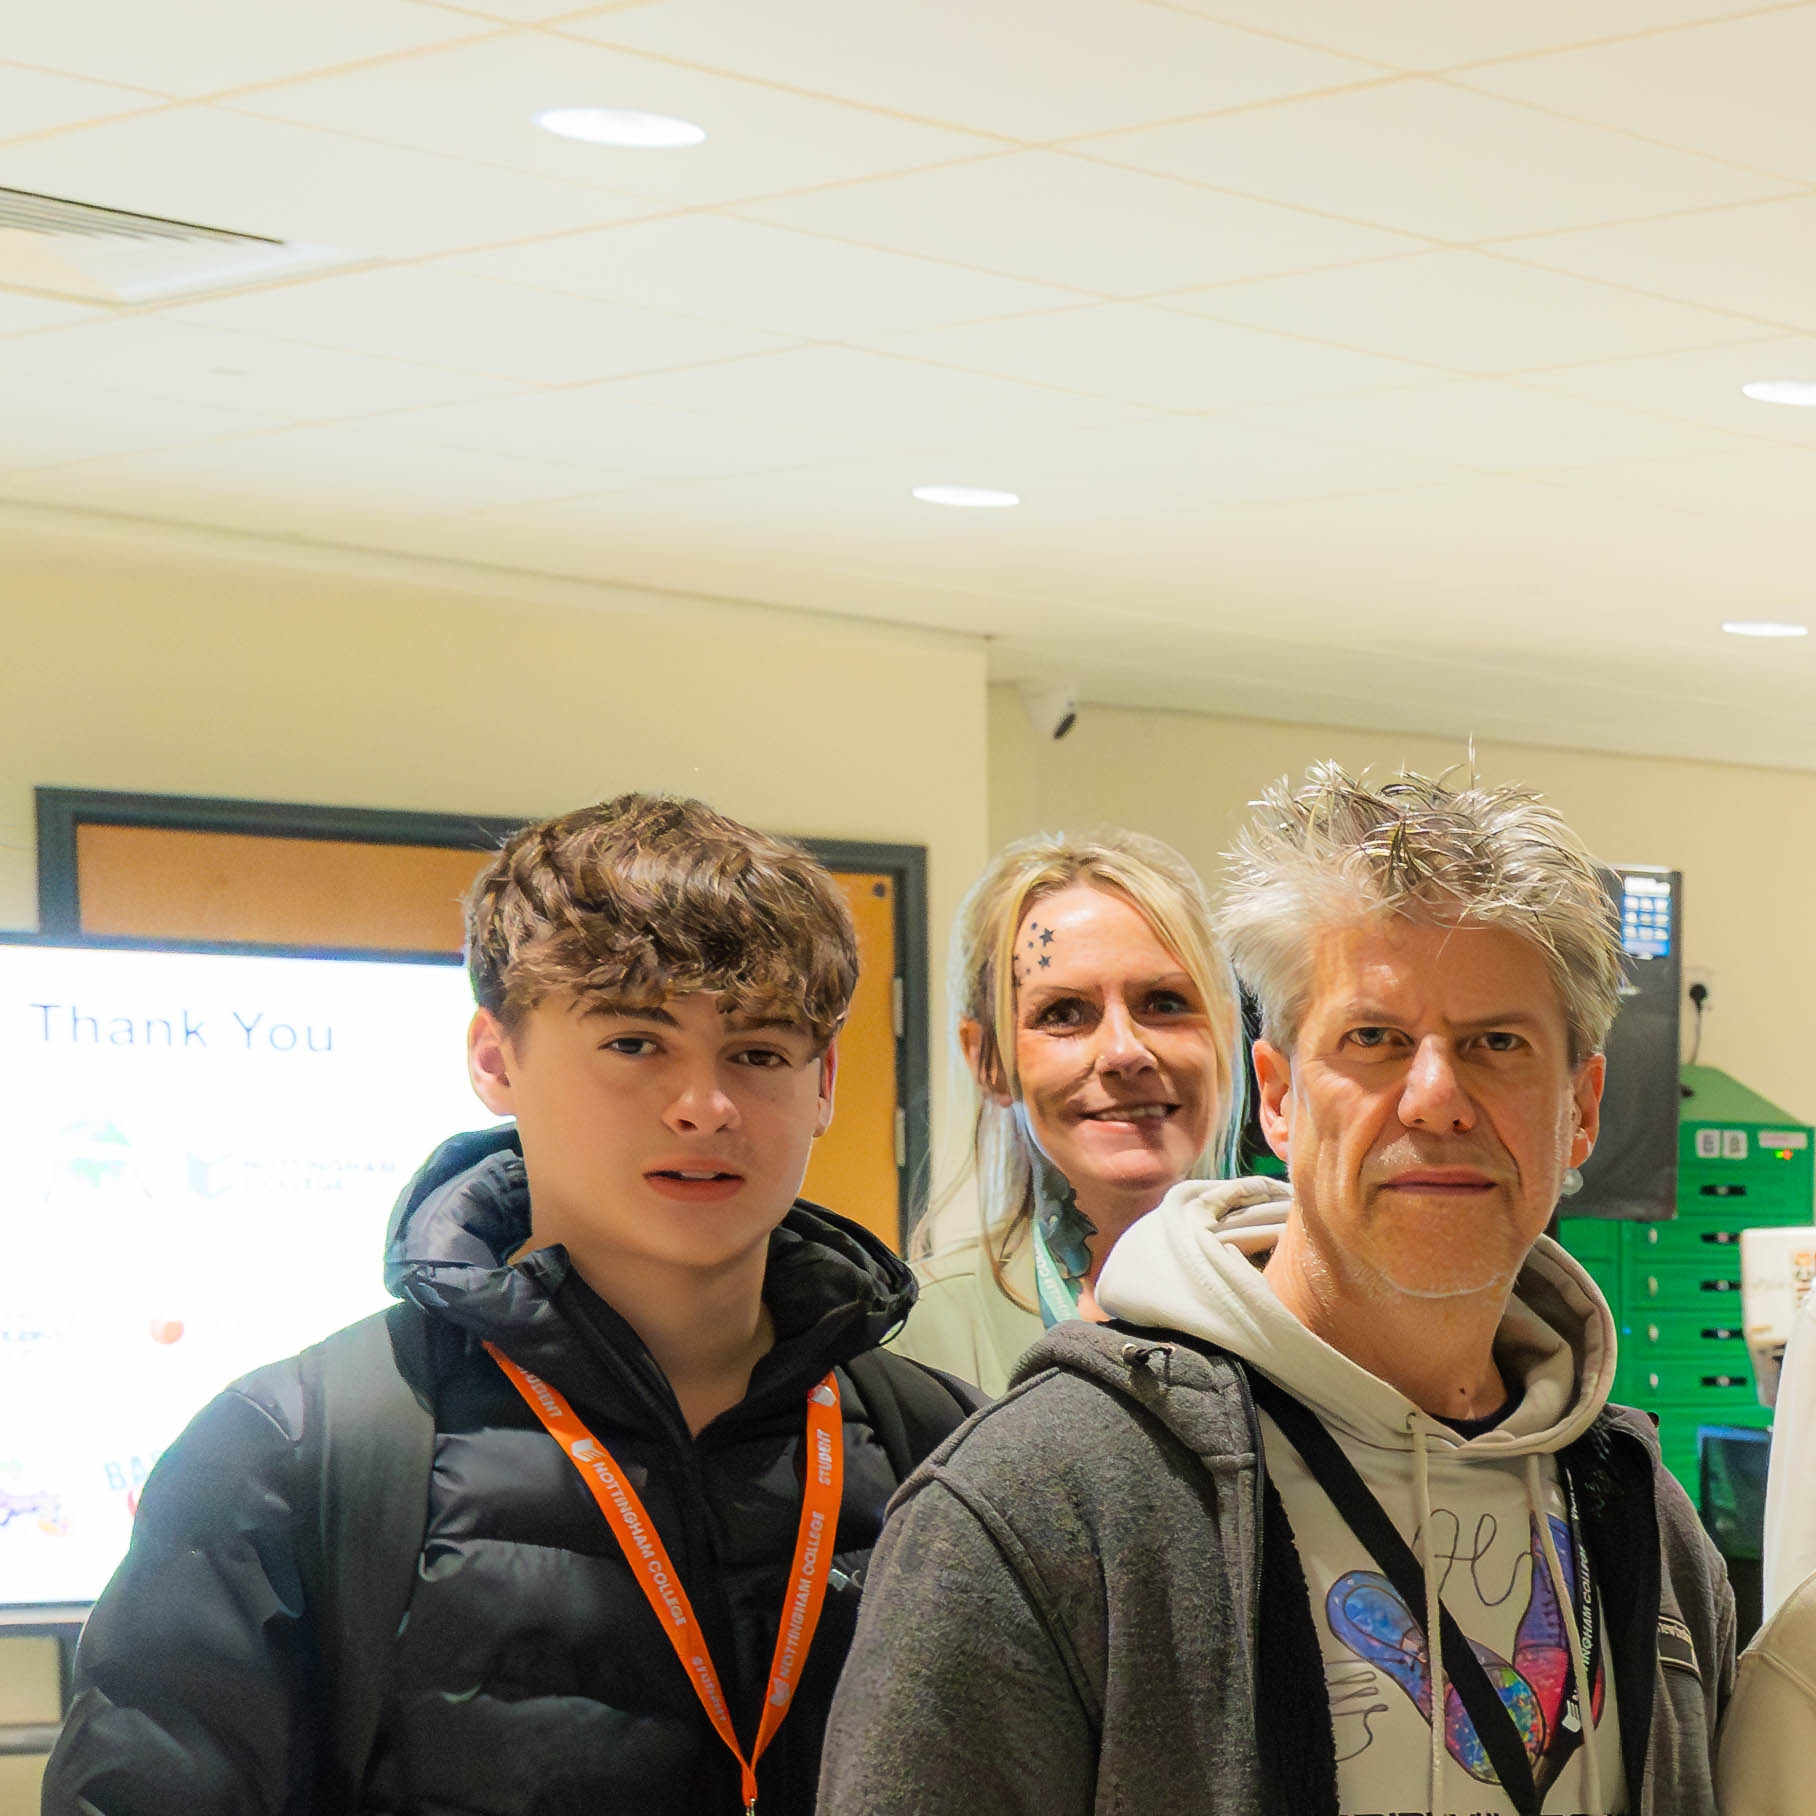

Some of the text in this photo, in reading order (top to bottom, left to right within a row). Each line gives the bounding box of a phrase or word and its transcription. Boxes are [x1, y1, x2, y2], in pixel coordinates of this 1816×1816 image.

[29, 1001, 335, 1053] Thank You
[816, 1429, 832, 1486] STUDENT
[592, 1462, 687, 1626] NOTTINGHAM COLLEGE
[779, 1510, 826, 1680] NOTTINGHAM COLLEGE
